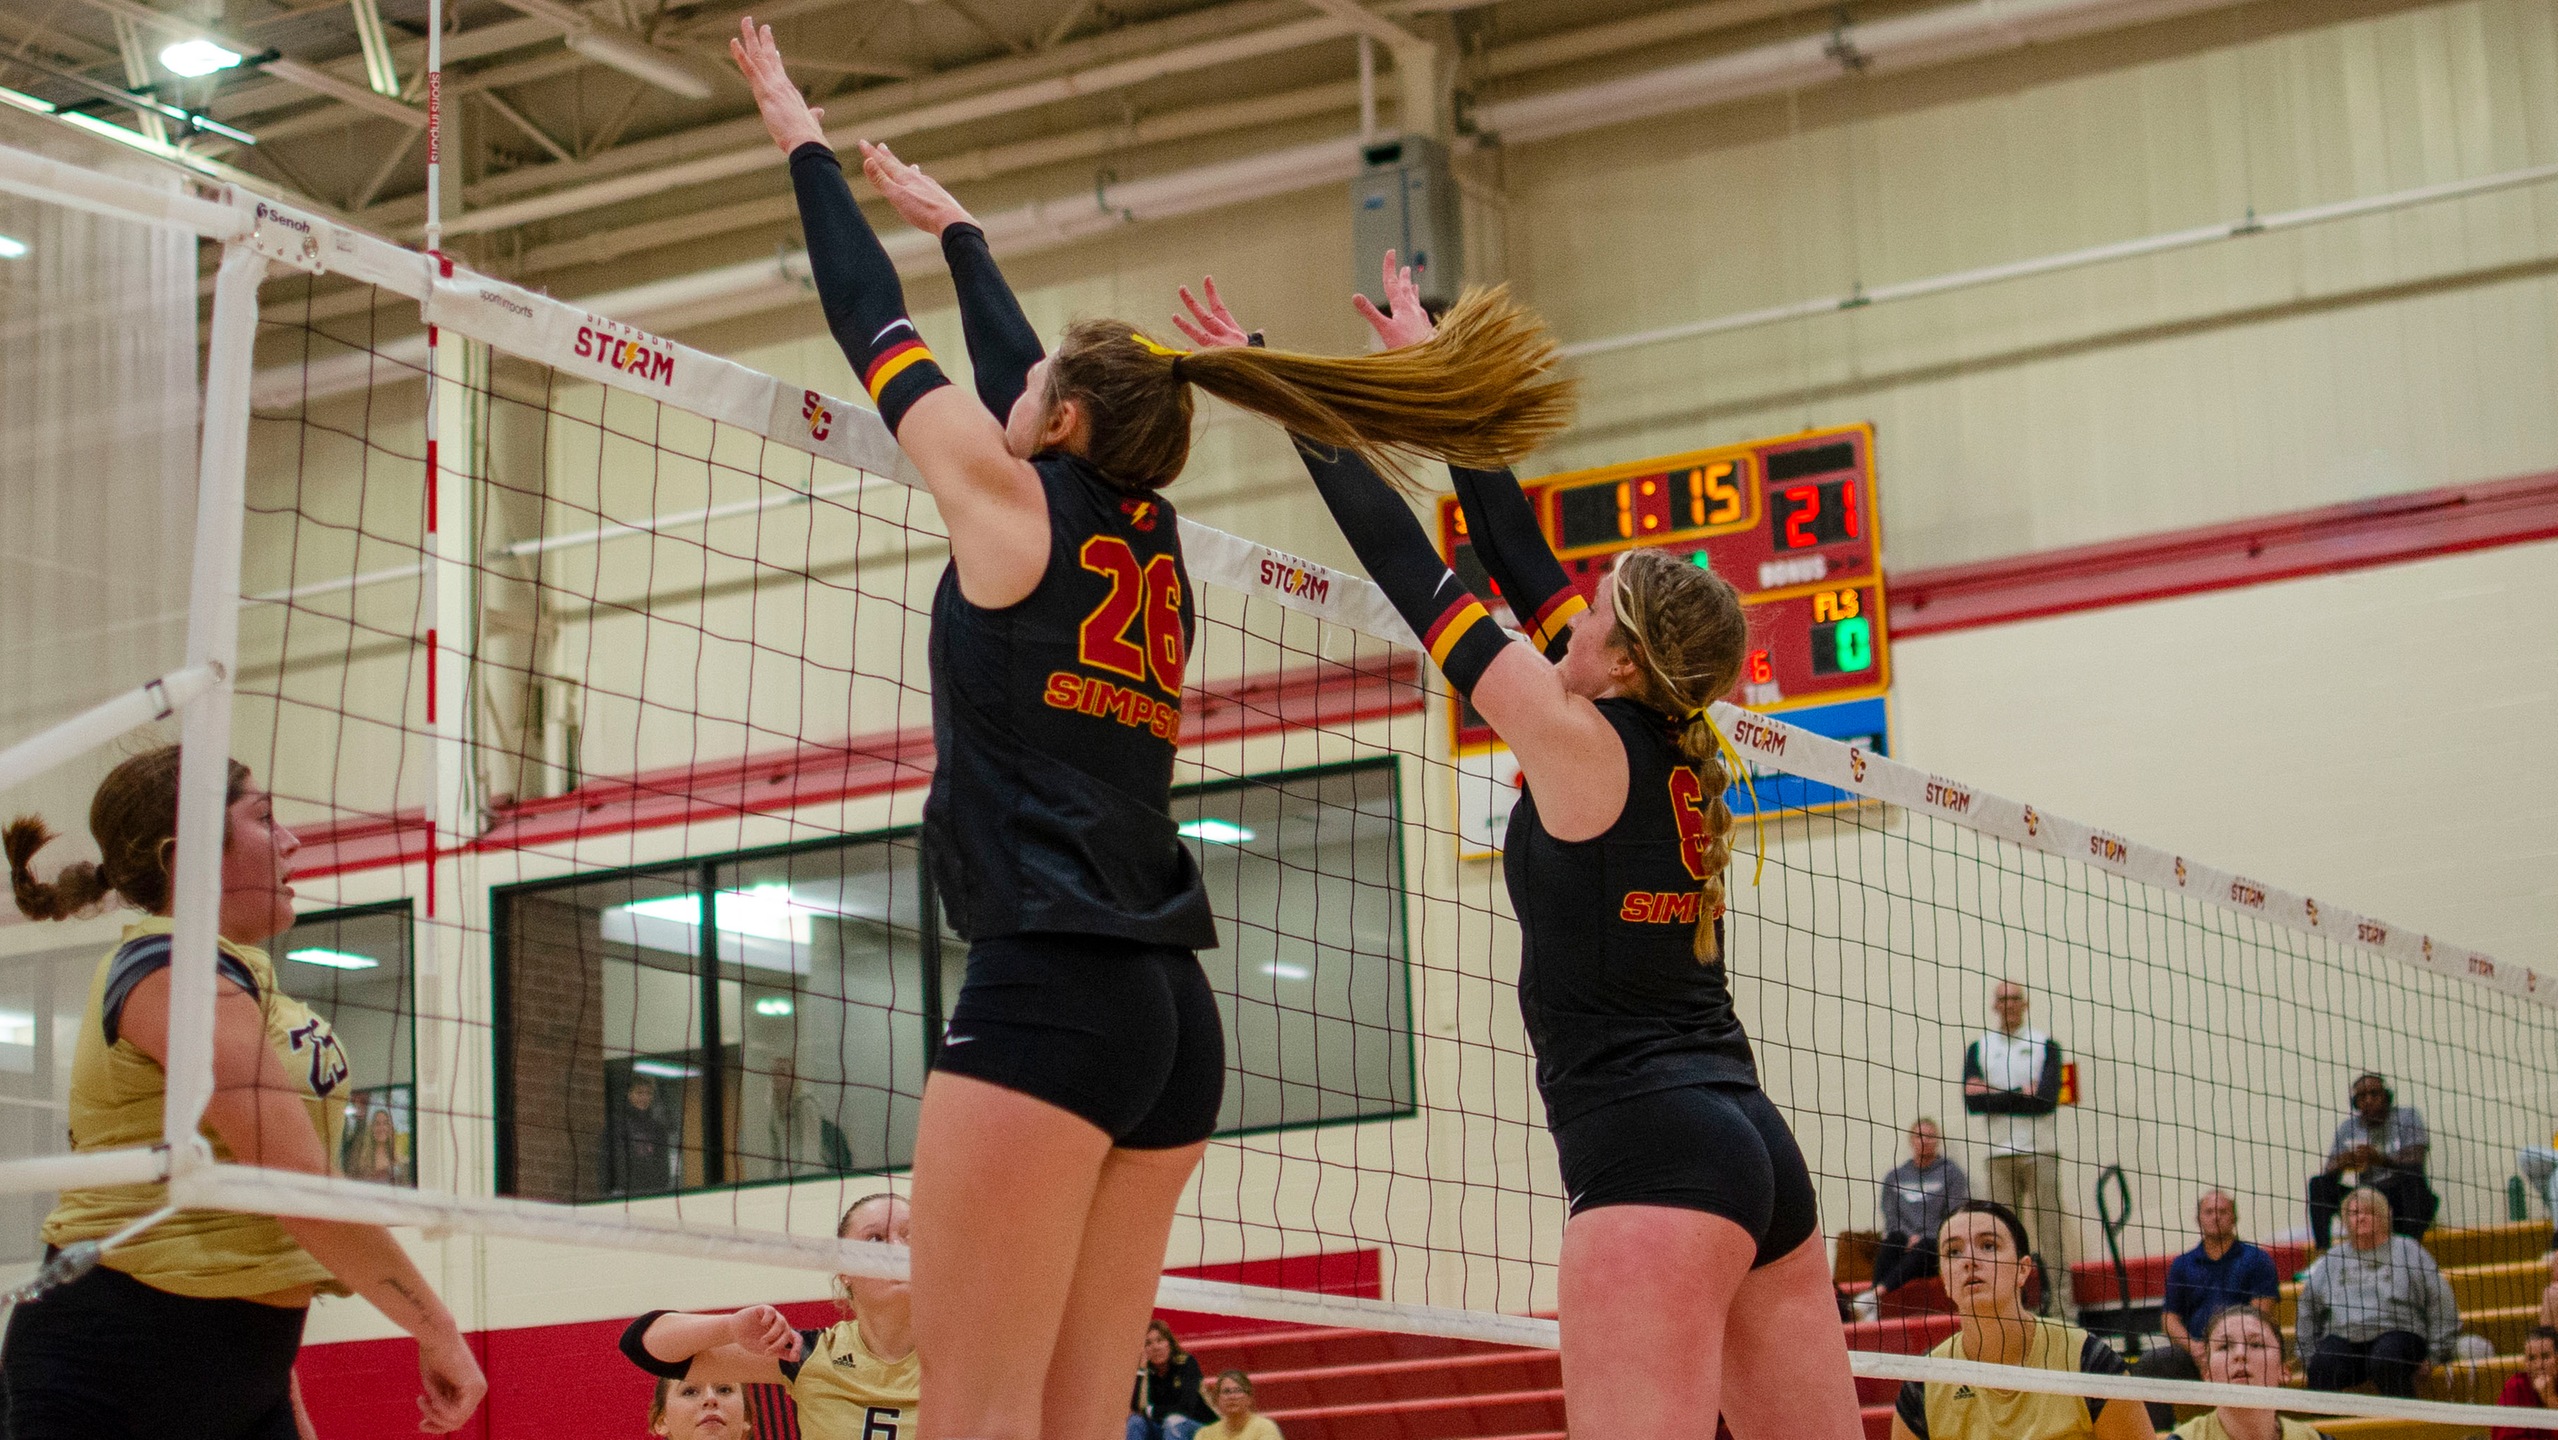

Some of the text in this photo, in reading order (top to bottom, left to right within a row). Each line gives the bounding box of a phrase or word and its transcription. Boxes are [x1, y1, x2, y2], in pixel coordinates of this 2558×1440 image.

[269, 209, 310, 233] Senoh
[574, 326, 674, 387] STORM
[1785, 479, 1859, 549] 21
[1260, 559, 1329, 605] STORM
[1079, 534, 1186, 698] 26
[1813, 588, 1860, 623] FLS
[1835, 616, 1873, 673] 0
[1734, 720, 1787, 757] STORM
[1926, 782, 1970, 814] STORM
[863, 1406, 901, 1440] 6
